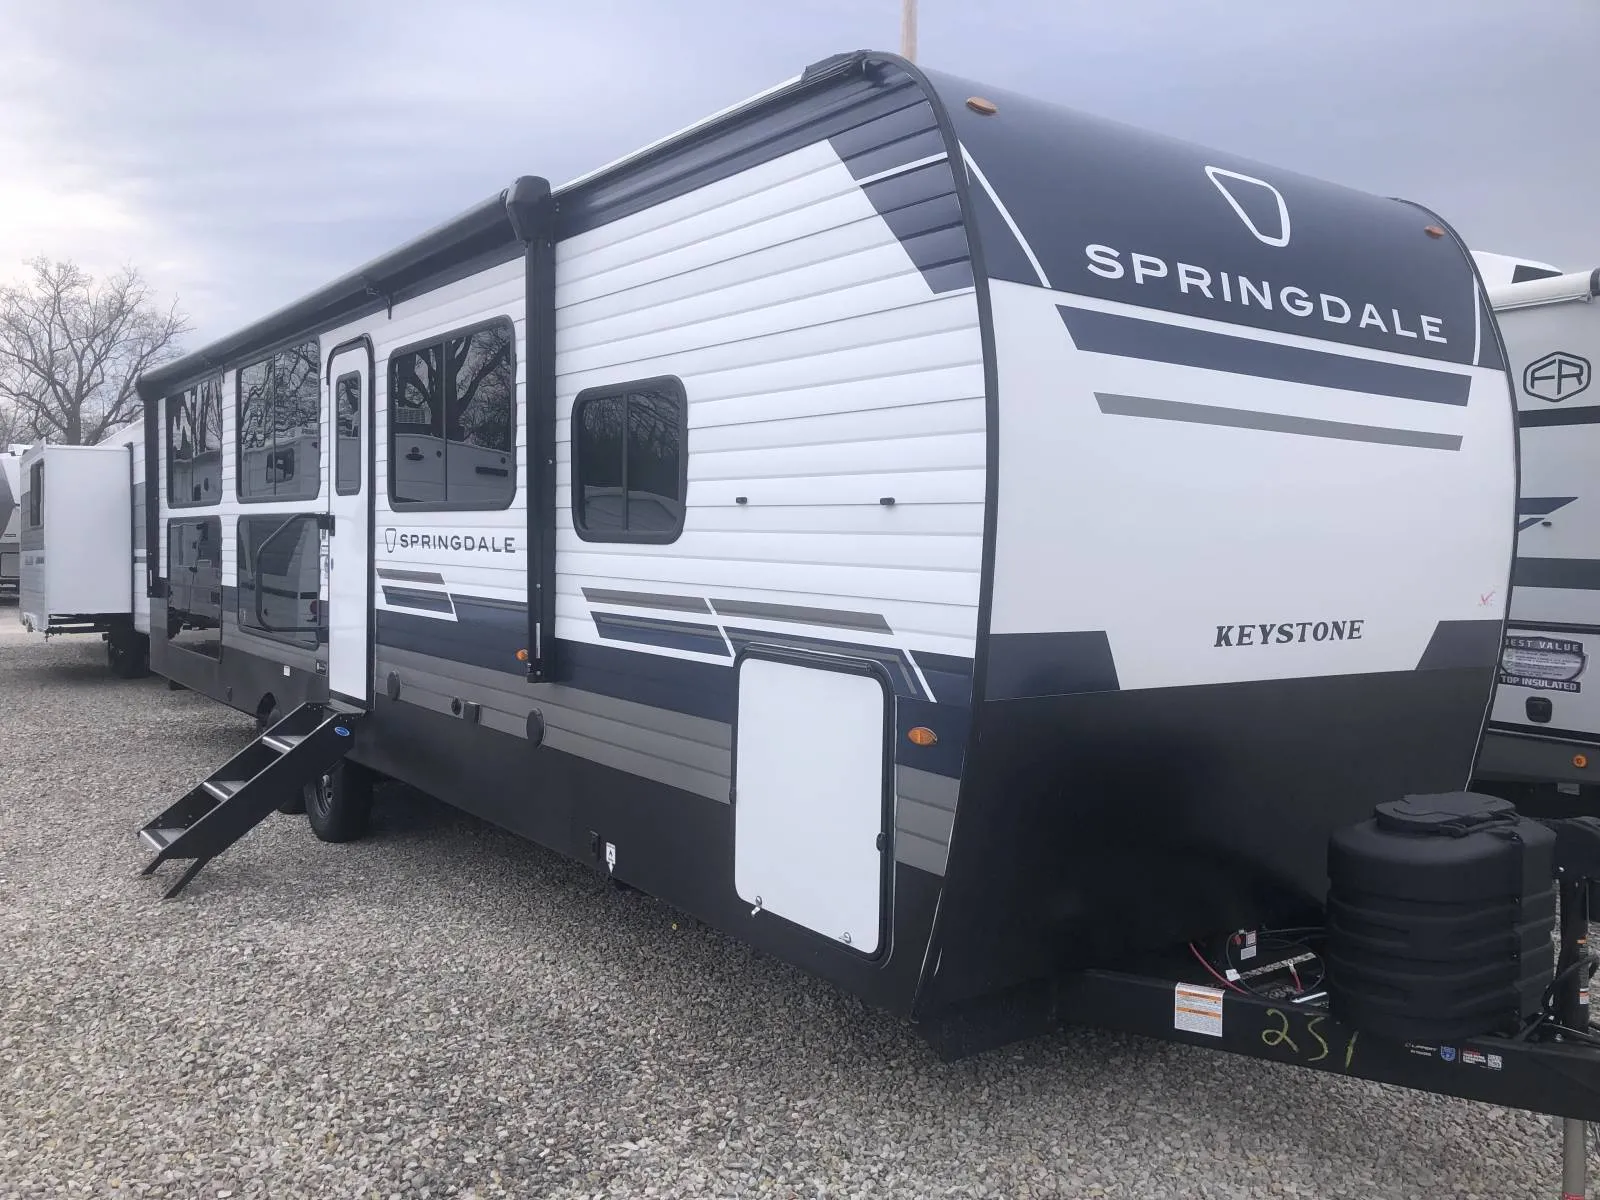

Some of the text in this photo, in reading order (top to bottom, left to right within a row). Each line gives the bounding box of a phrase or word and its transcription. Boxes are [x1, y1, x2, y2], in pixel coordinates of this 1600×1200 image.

[1085, 244, 1448, 344] SPRINGDALE
[400, 534, 516, 553] SPRINGDALE
[1214, 620, 1364, 648] KEYSTONE
[1539, 641, 1579, 652] VALUE
[1501, 675, 1577, 691] TOP INSULATED
